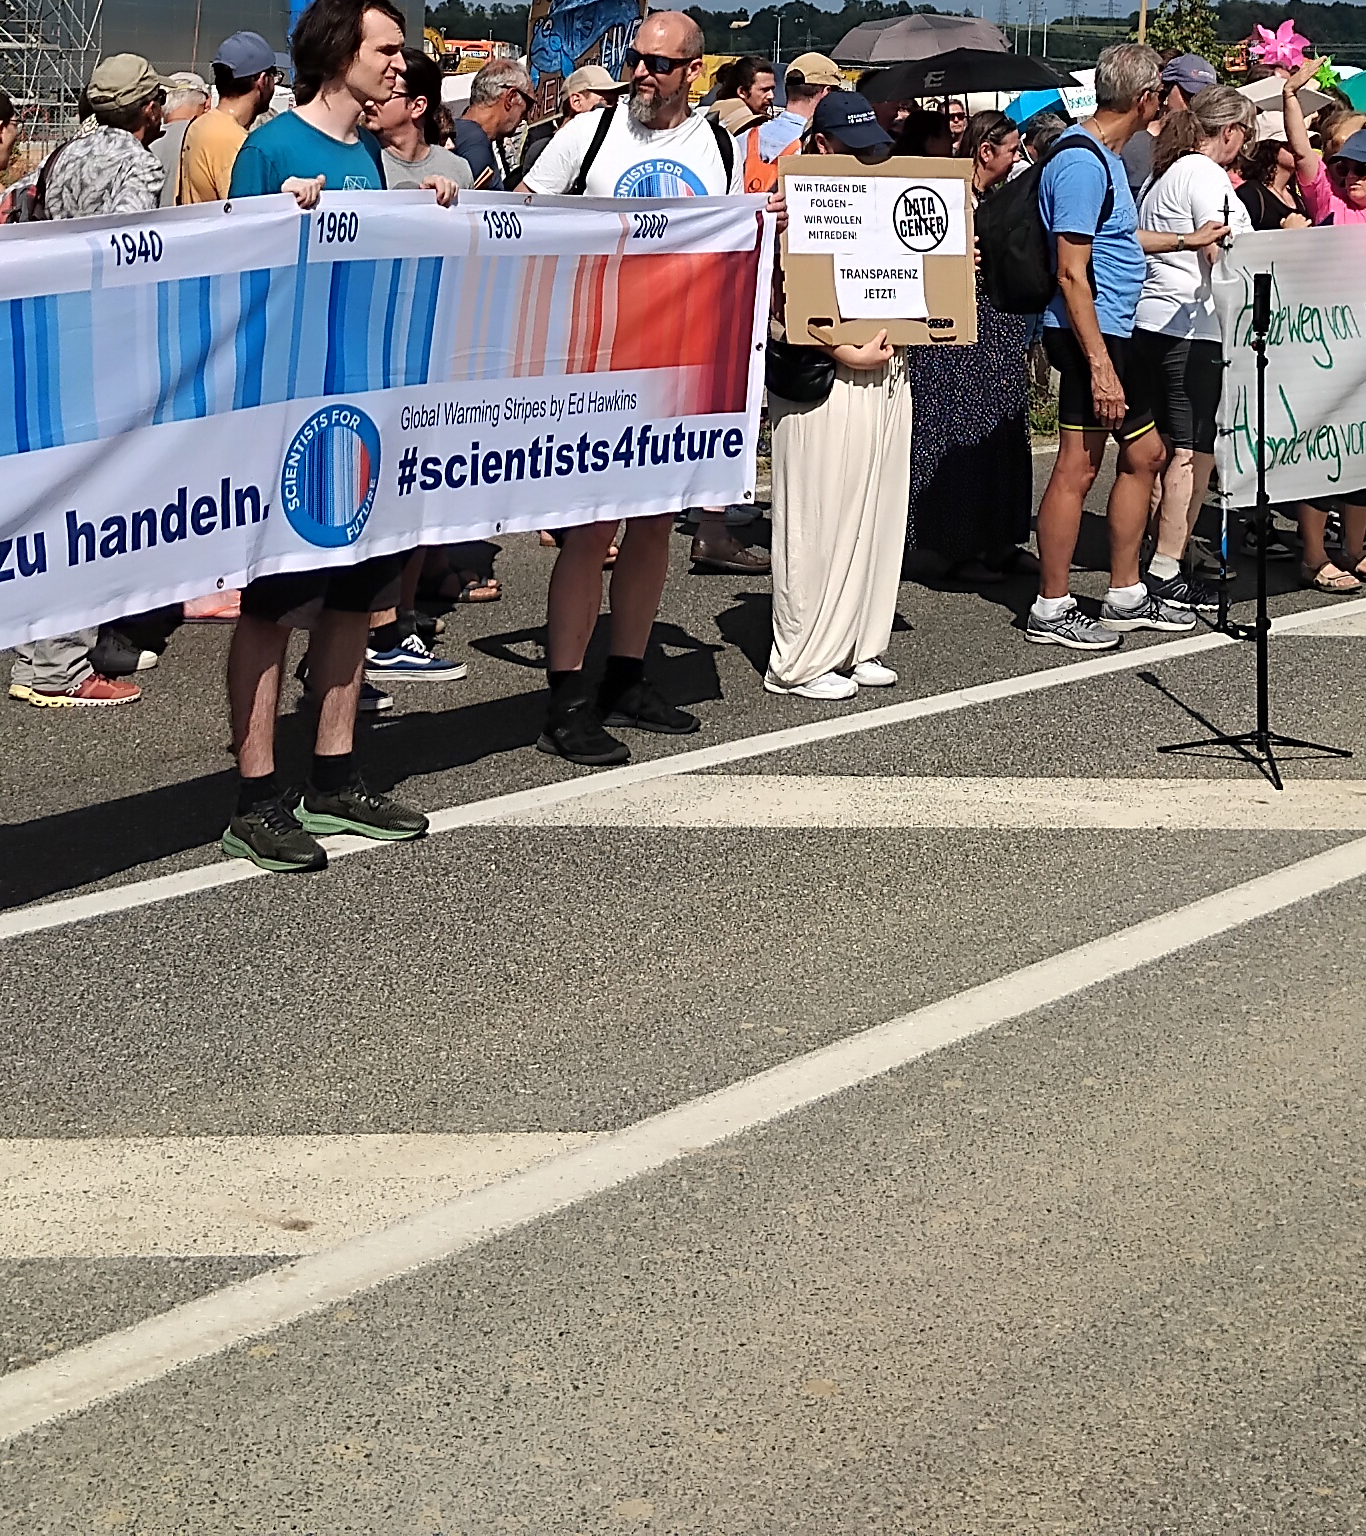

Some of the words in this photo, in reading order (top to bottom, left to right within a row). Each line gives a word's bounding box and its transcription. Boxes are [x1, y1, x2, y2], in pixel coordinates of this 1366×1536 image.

[656, 162, 683, 177] FOR
[794, 183, 813, 192] WIR
[815, 183, 850, 193] TRAGEN
[852, 184, 867, 193] DIE
[810, 199, 846, 208] FOLGEN
[903, 196, 936, 217] DATA
[804, 215, 823, 224] WIR
[824, 215, 862, 224] WOLLEN
[899, 215, 945, 238] CENTER
[110, 229, 164, 267] 1940
[316, 211, 359, 243] 1960
[482, 209, 523, 240] 1980
[632, 213, 669, 239] 2000
[808, 230, 857, 240] MITREDEN!
[840, 268, 919, 279] TRANSPARENZ
[864, 288, 897, 300] JETZT!
[1234, 261, 1283, 348] Hnde
[1288, 302, 1333, 369] weg
[1325, 302, 1361, 340] von
[400, 402, 440, 430] Global
[444, 400, 501, 427] Warming
[504, 396, 546, 424] Stripes
[549, 394, 565, 421] by
[568, 391, 584, 415] Ed
[588, 389, 637, 413] Hawkins
[398, 421, 743, 496] #scientists4future
[1306, 423, 1341, 483] weg
[285, 413, 328, 512] SCIENTISTS
[331, 410, 361, 430] FOR
[346, 478, 376, 541] FUTURE
[65, 477, 271, 566] handeln.
